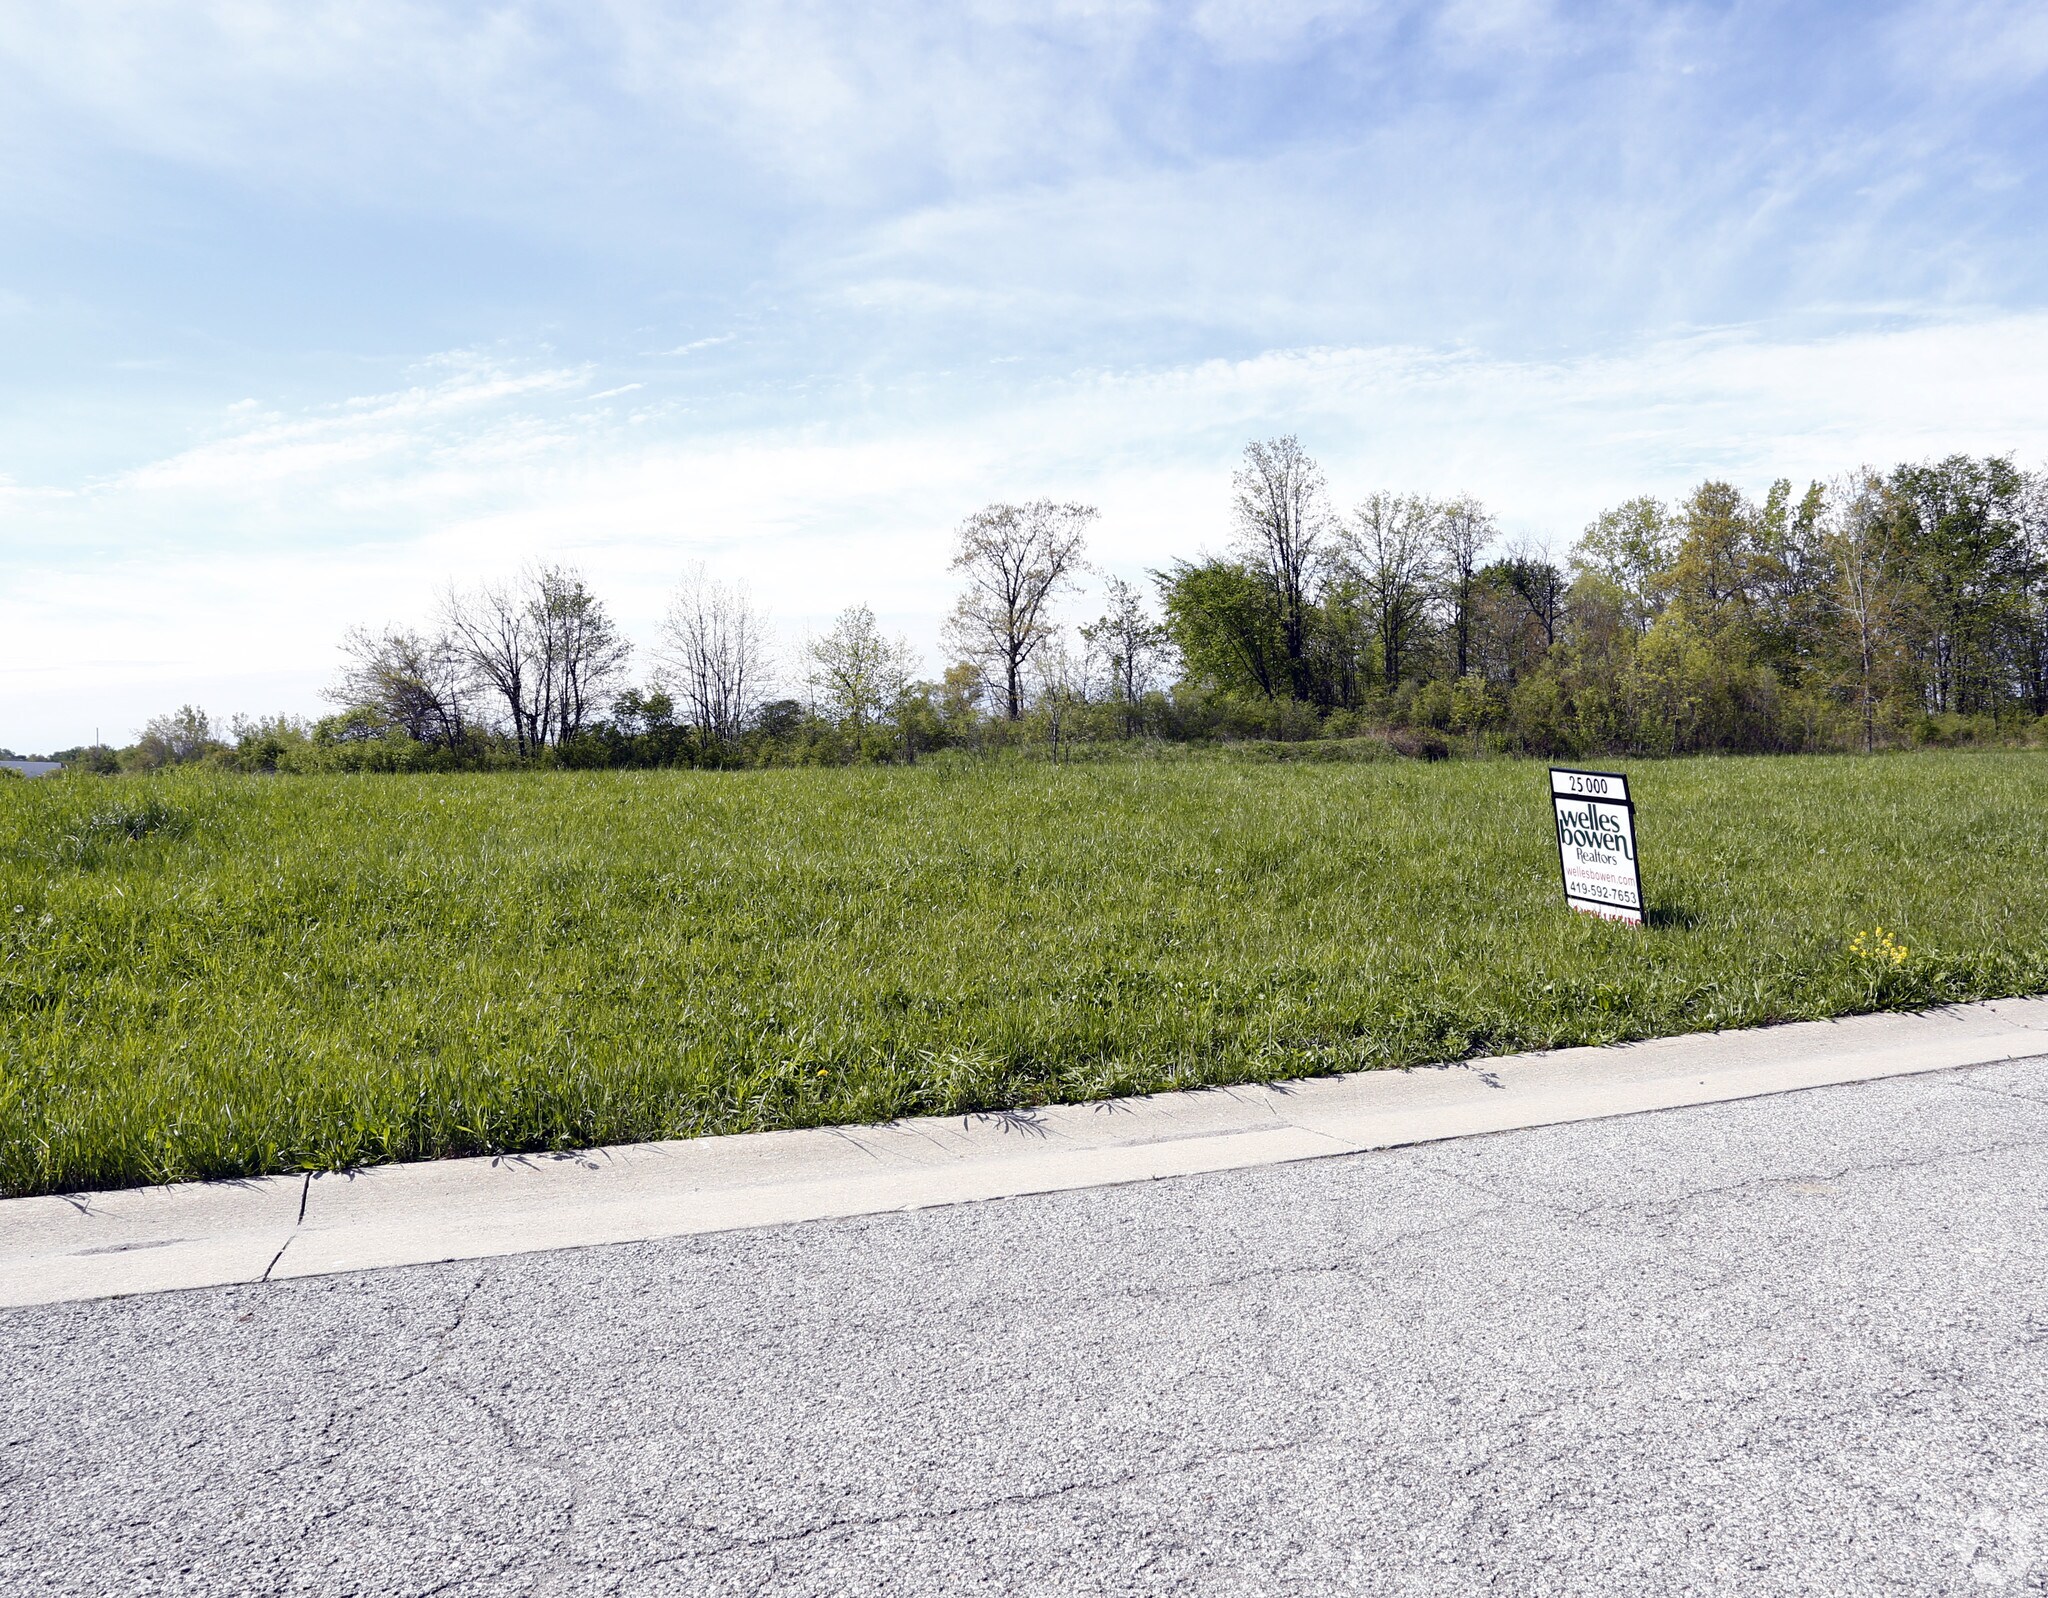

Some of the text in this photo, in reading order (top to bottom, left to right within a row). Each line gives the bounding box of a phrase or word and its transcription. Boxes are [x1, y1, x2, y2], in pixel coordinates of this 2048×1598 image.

[1560, 803, 1620, 833] welles
[1559, 819, 1634, 861] bowen
[1576, 847, 1617, 866] Realtors
[1566, 867, 1636, 887] wellesbowen.com
[1570, 881, 1637, 904] 419-592-7653
